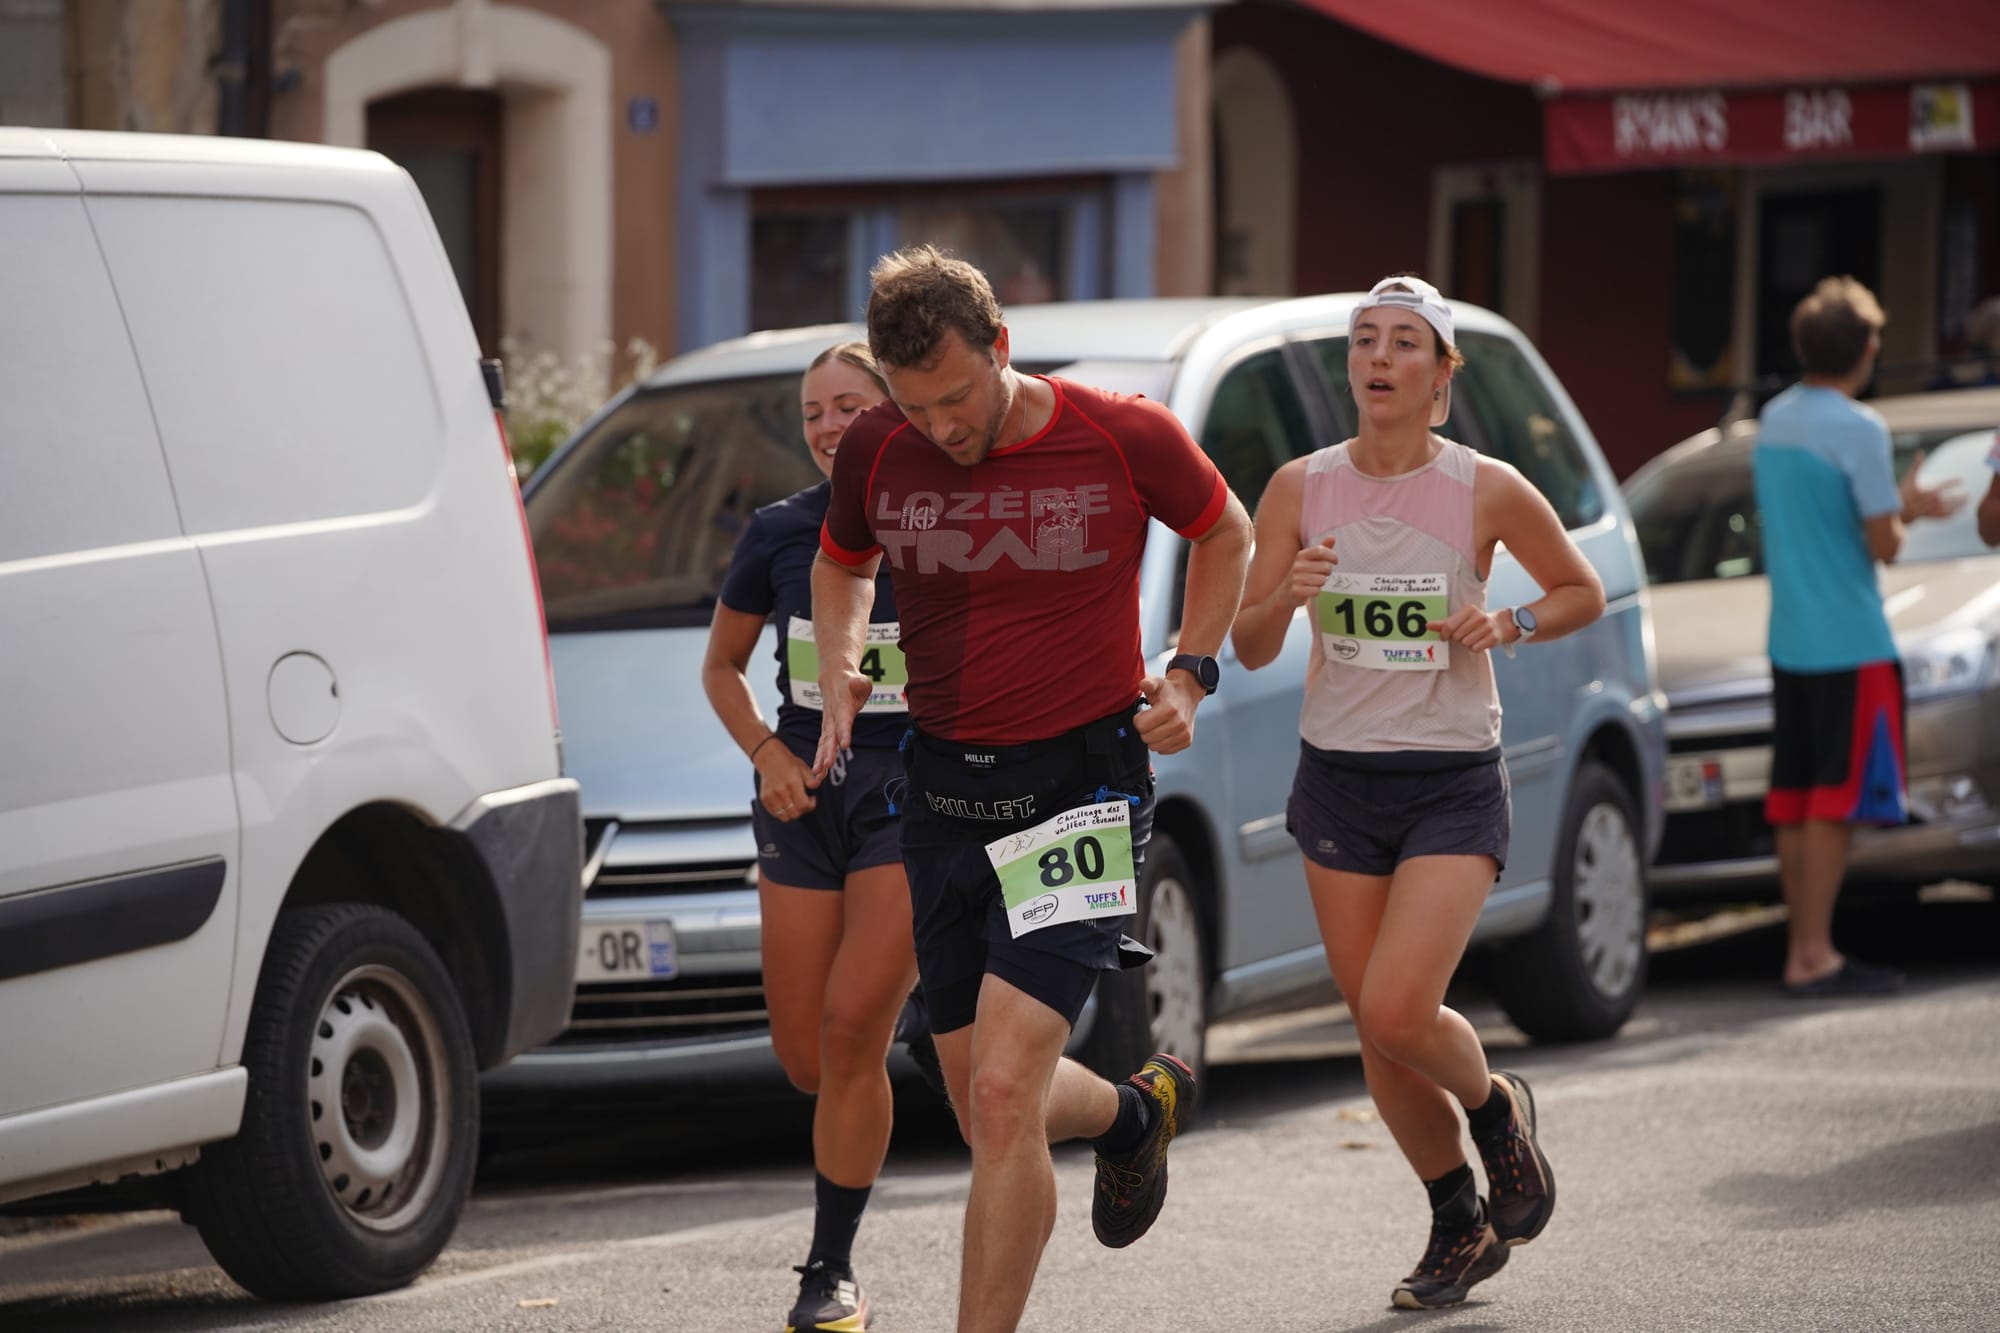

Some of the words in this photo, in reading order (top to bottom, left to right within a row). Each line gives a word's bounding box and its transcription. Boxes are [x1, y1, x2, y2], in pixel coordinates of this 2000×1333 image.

[1613, 91, 1728, 156] RYAN'S
[1784, 90, 1851, 149] BAR
[877, 484, 1110, 520] LOZÈRE
[876, 525, 1109, 576] TRAIL
[1335, 598, 1428, 638] 166
[1057, 808, 1103, 825] Challenge
[1038, 836, 1105, 887] 80
[1022, 902, 1054, 920] BFP
[1084, 891, 1118, 904] TUFF'S
